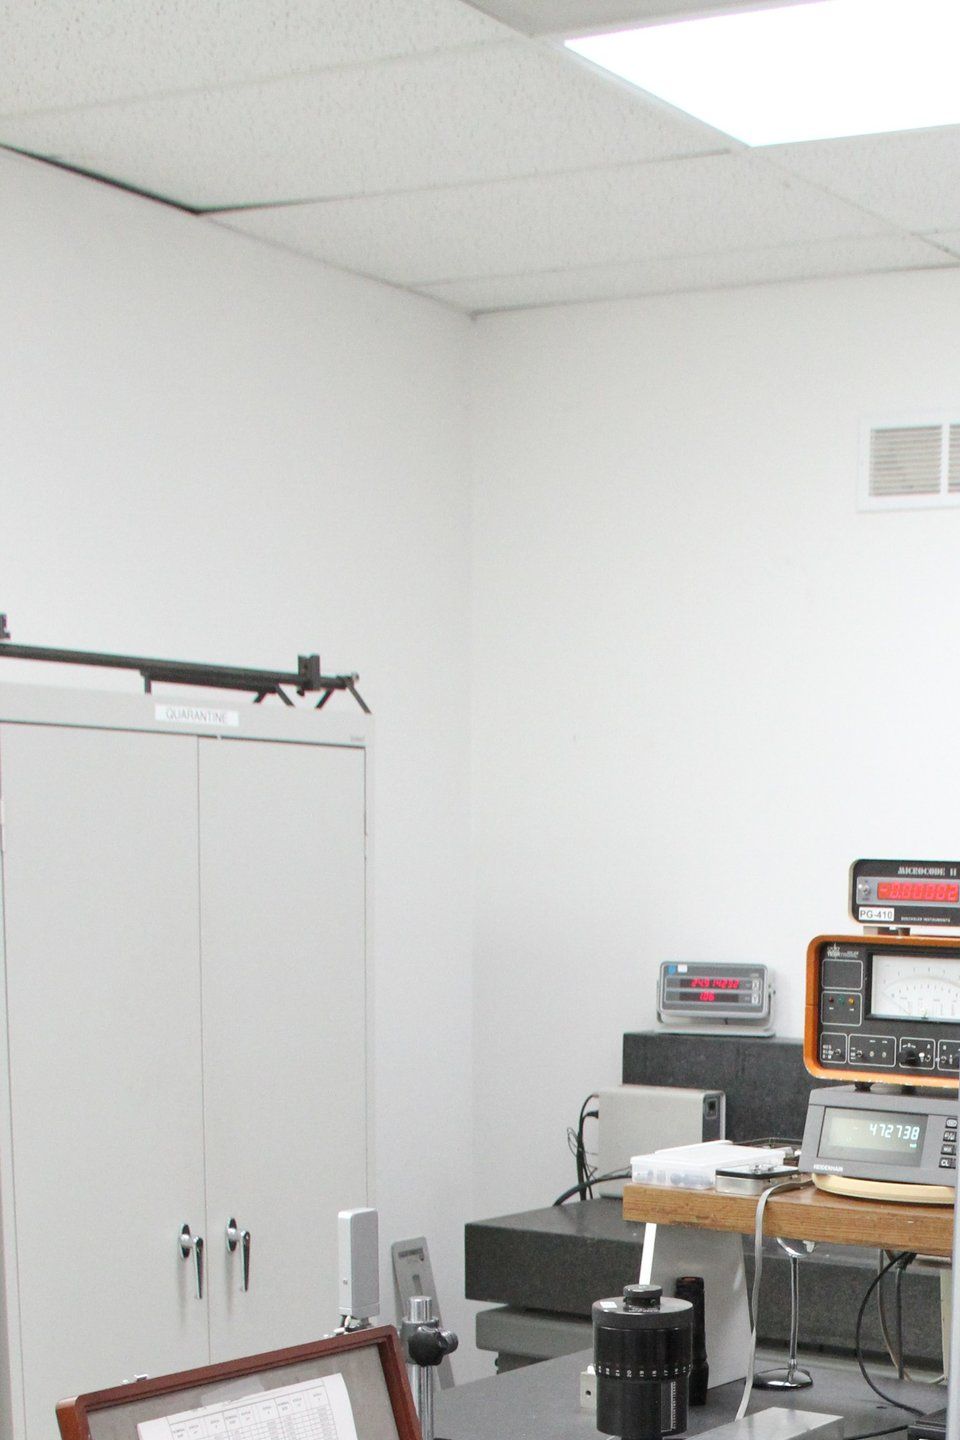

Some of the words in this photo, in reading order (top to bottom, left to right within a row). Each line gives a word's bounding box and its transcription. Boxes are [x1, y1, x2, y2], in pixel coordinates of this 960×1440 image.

[898, 866, 946, 876] MICROCODE
[860, 909, 893, 919] PG-410
[869, 1123, 920, 1140] 472738
